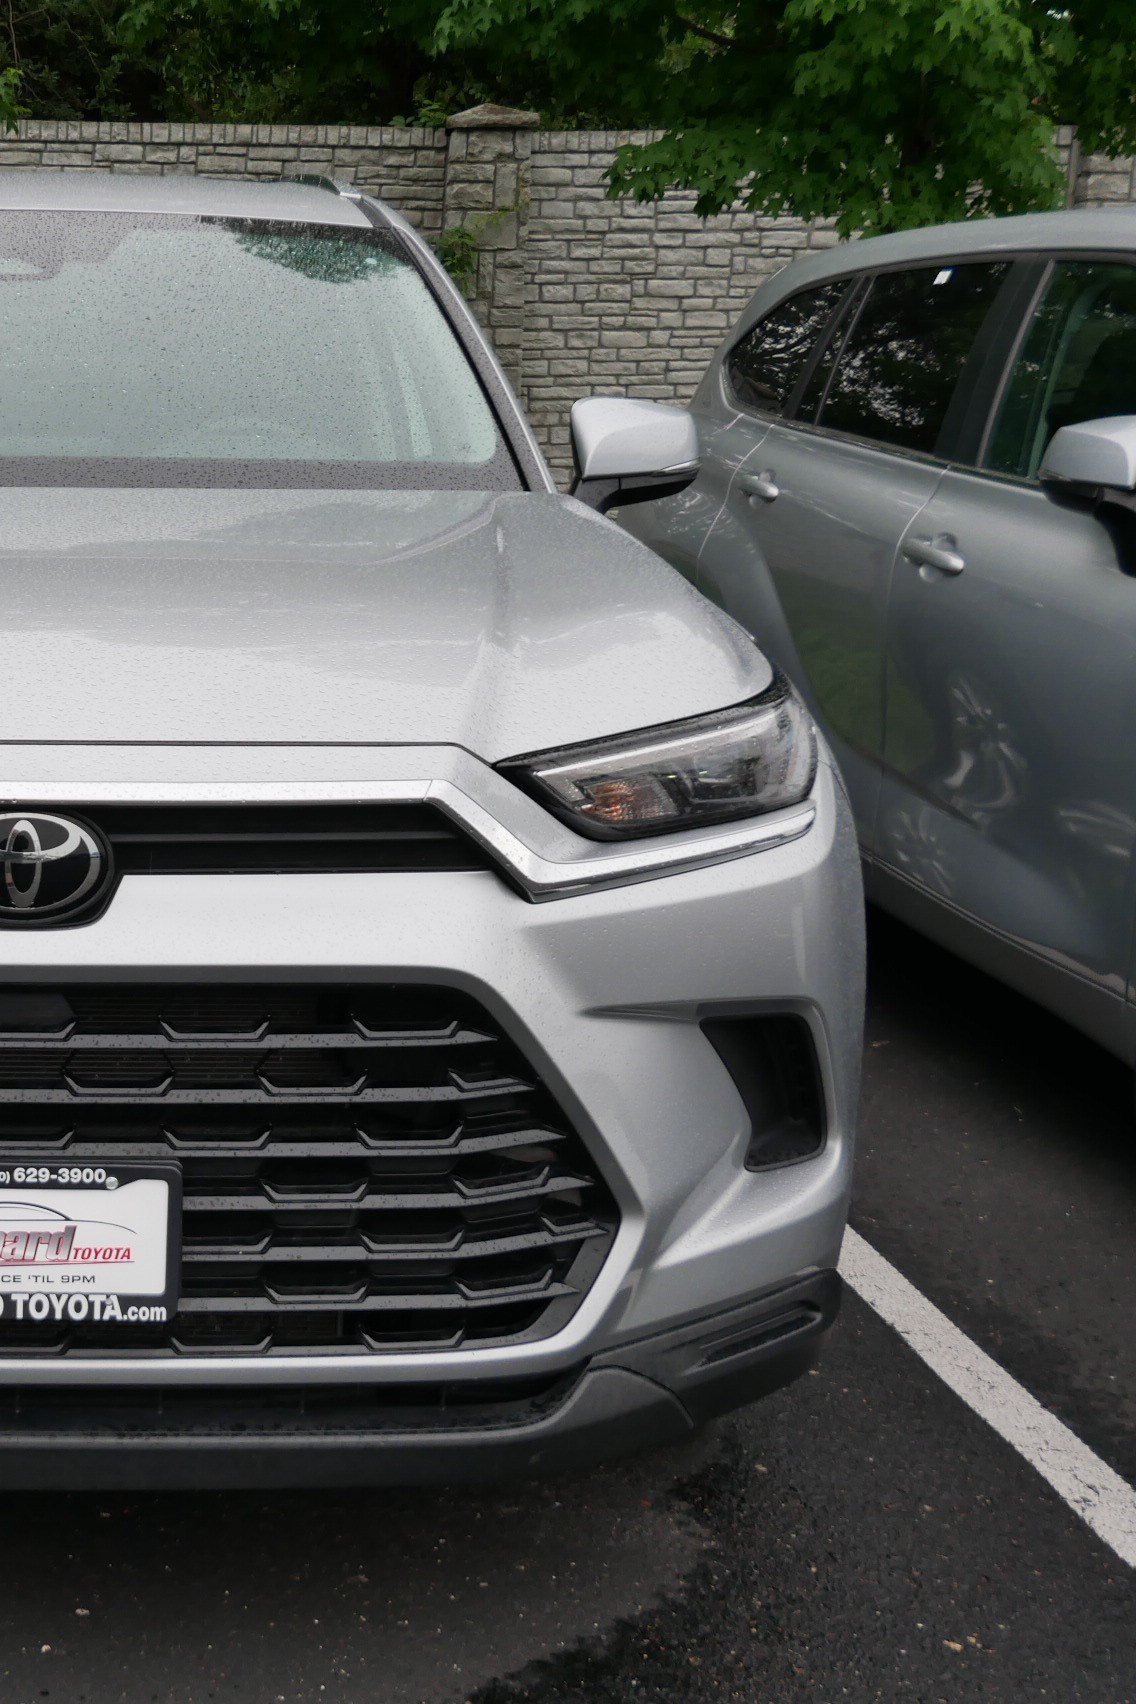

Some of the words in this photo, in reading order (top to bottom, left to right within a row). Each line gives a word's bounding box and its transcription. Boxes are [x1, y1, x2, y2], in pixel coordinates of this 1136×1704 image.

[13, 1167, 107, 1183] 629-3900
[73, 1247, 131, 1260] TOYOTA
[61, 1275, 96, 1284] 9PM
[11, 1292, 167, 1321] TOYOTA.com
